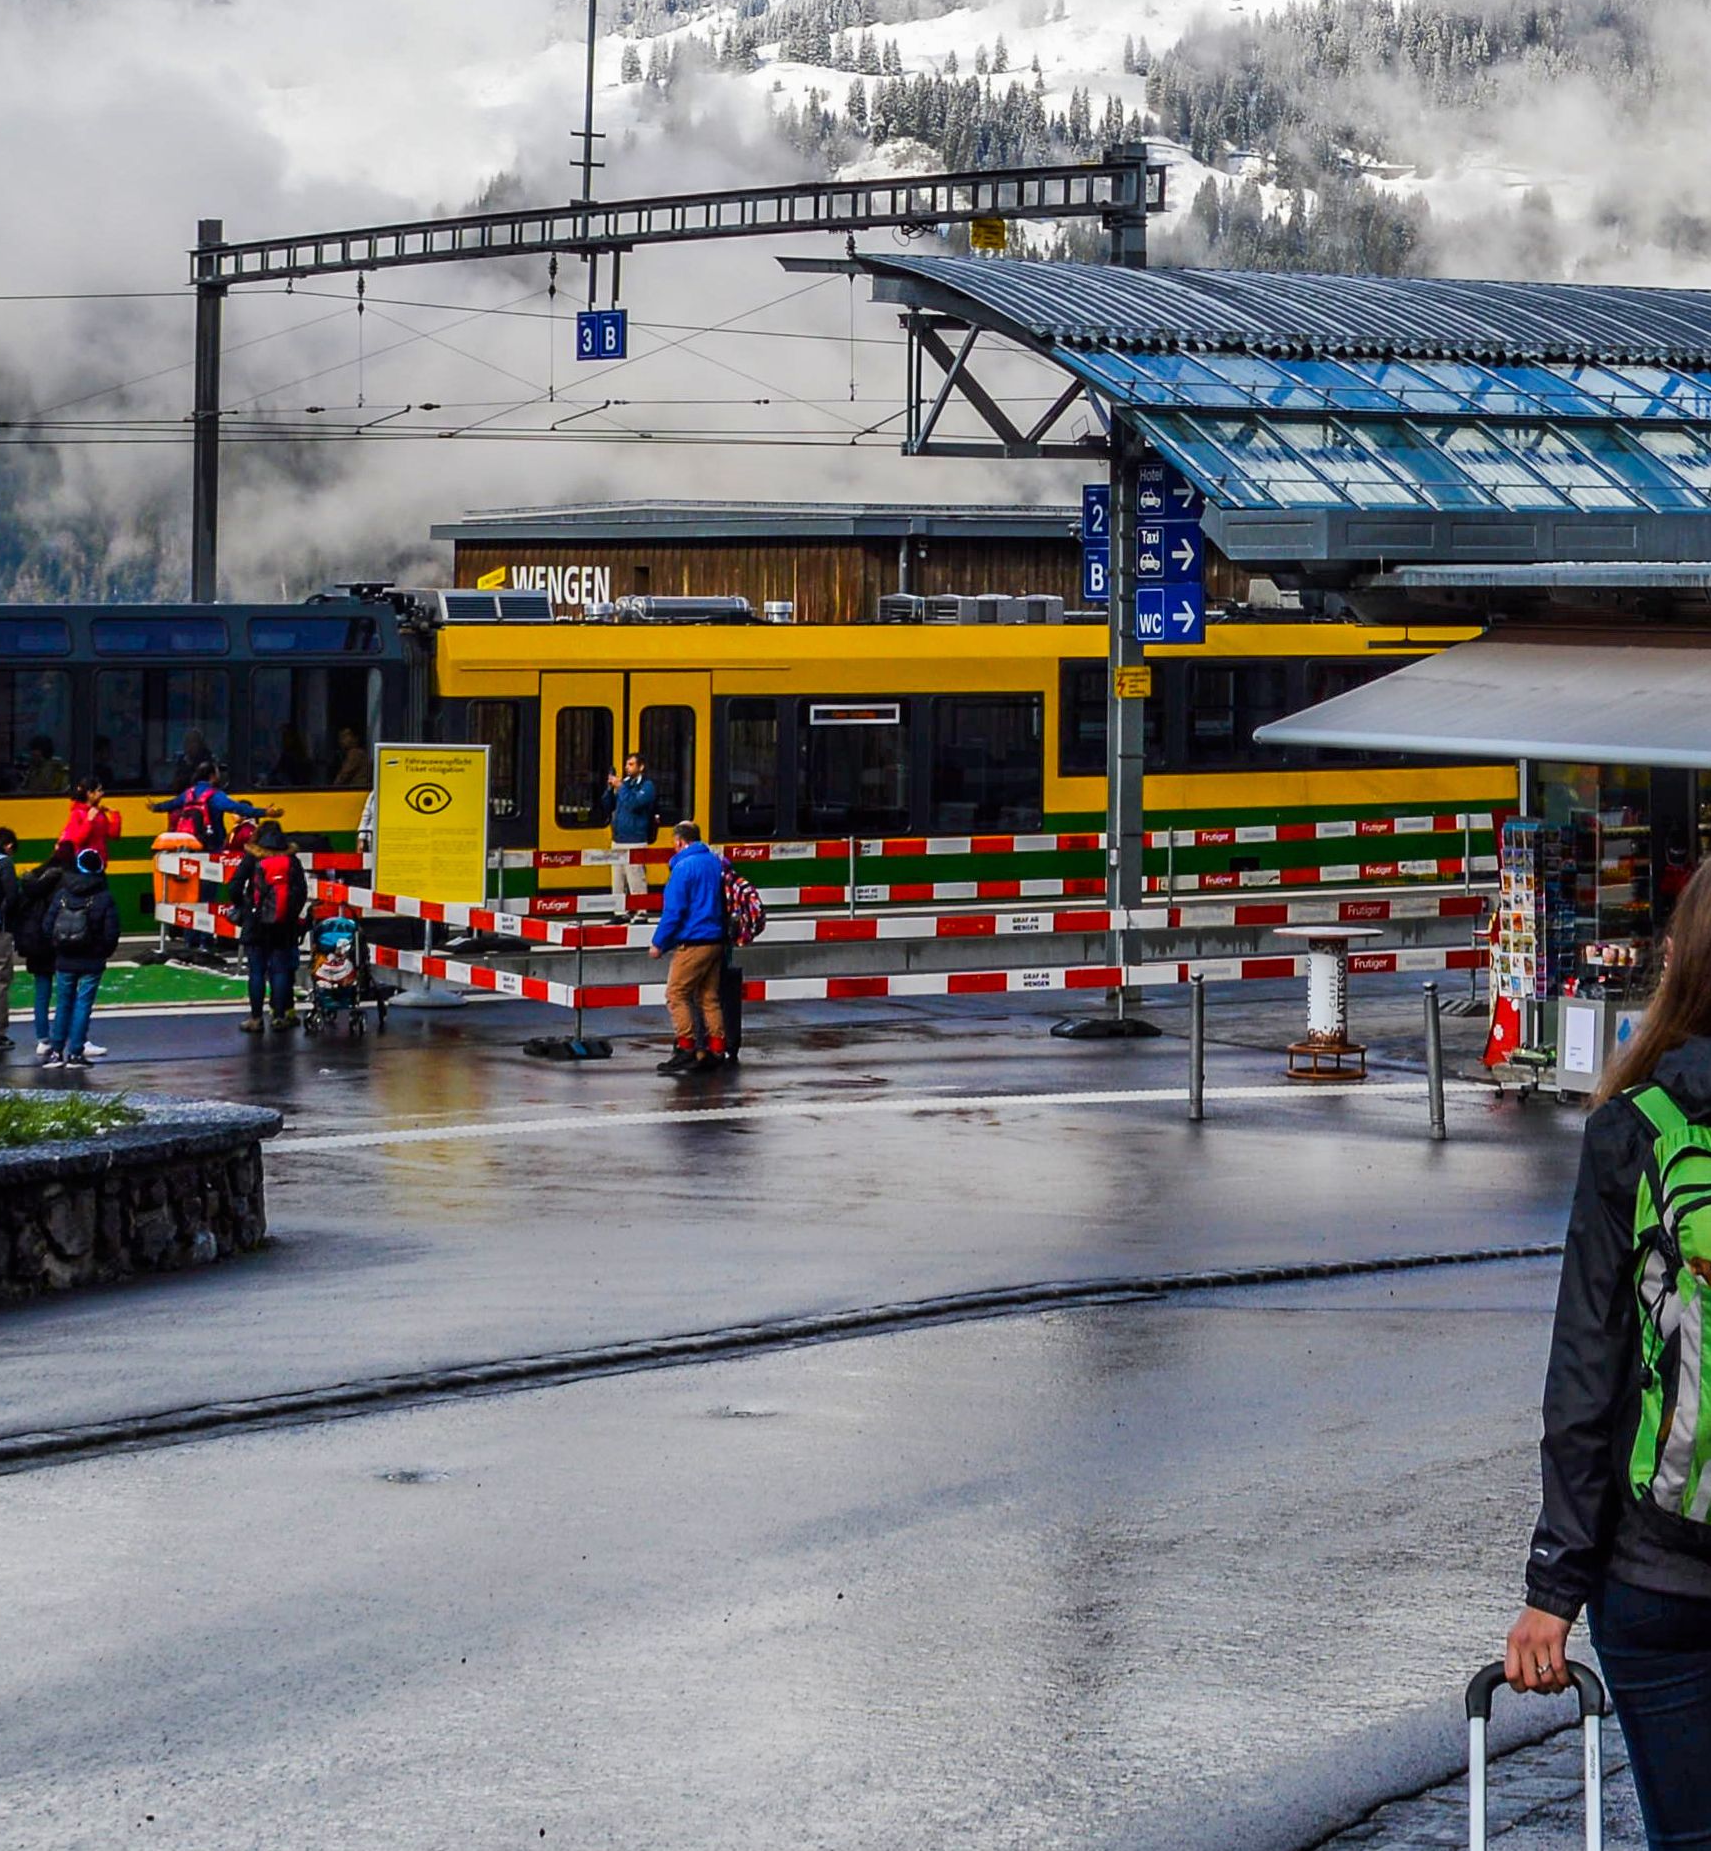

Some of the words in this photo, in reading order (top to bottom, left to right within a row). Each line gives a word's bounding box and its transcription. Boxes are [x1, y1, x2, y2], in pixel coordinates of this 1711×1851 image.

[582, 327, 593, 353] 3
[605, 326, 616, 351] B
[1139, 468, 1163, 482] Hotel
[1091, 504, 1104, 533] 2
[1141, 530, 1160, 545] Taxi
[1090, 562, 1104, 592] B
[511, 565, 611, 605] WENGEN
[1139, 613, 1162, 634] WC
[1361, 820, 1389, 834] Frutiger
[1201, 831, 1229, 845] Frutiger
[541, 852, 575, 867] Frutiger
[732, 845, 765, 859] Frutiger
[1365, 864, 1393, 877] Frutiger
[1204, 874, 1233, 887] Frutiger
[536, 899, 570, 912] Frutiger
[1347, 903, 1382, 918] Frutiger
[1354, 956, 1389, 971] Frutiger
